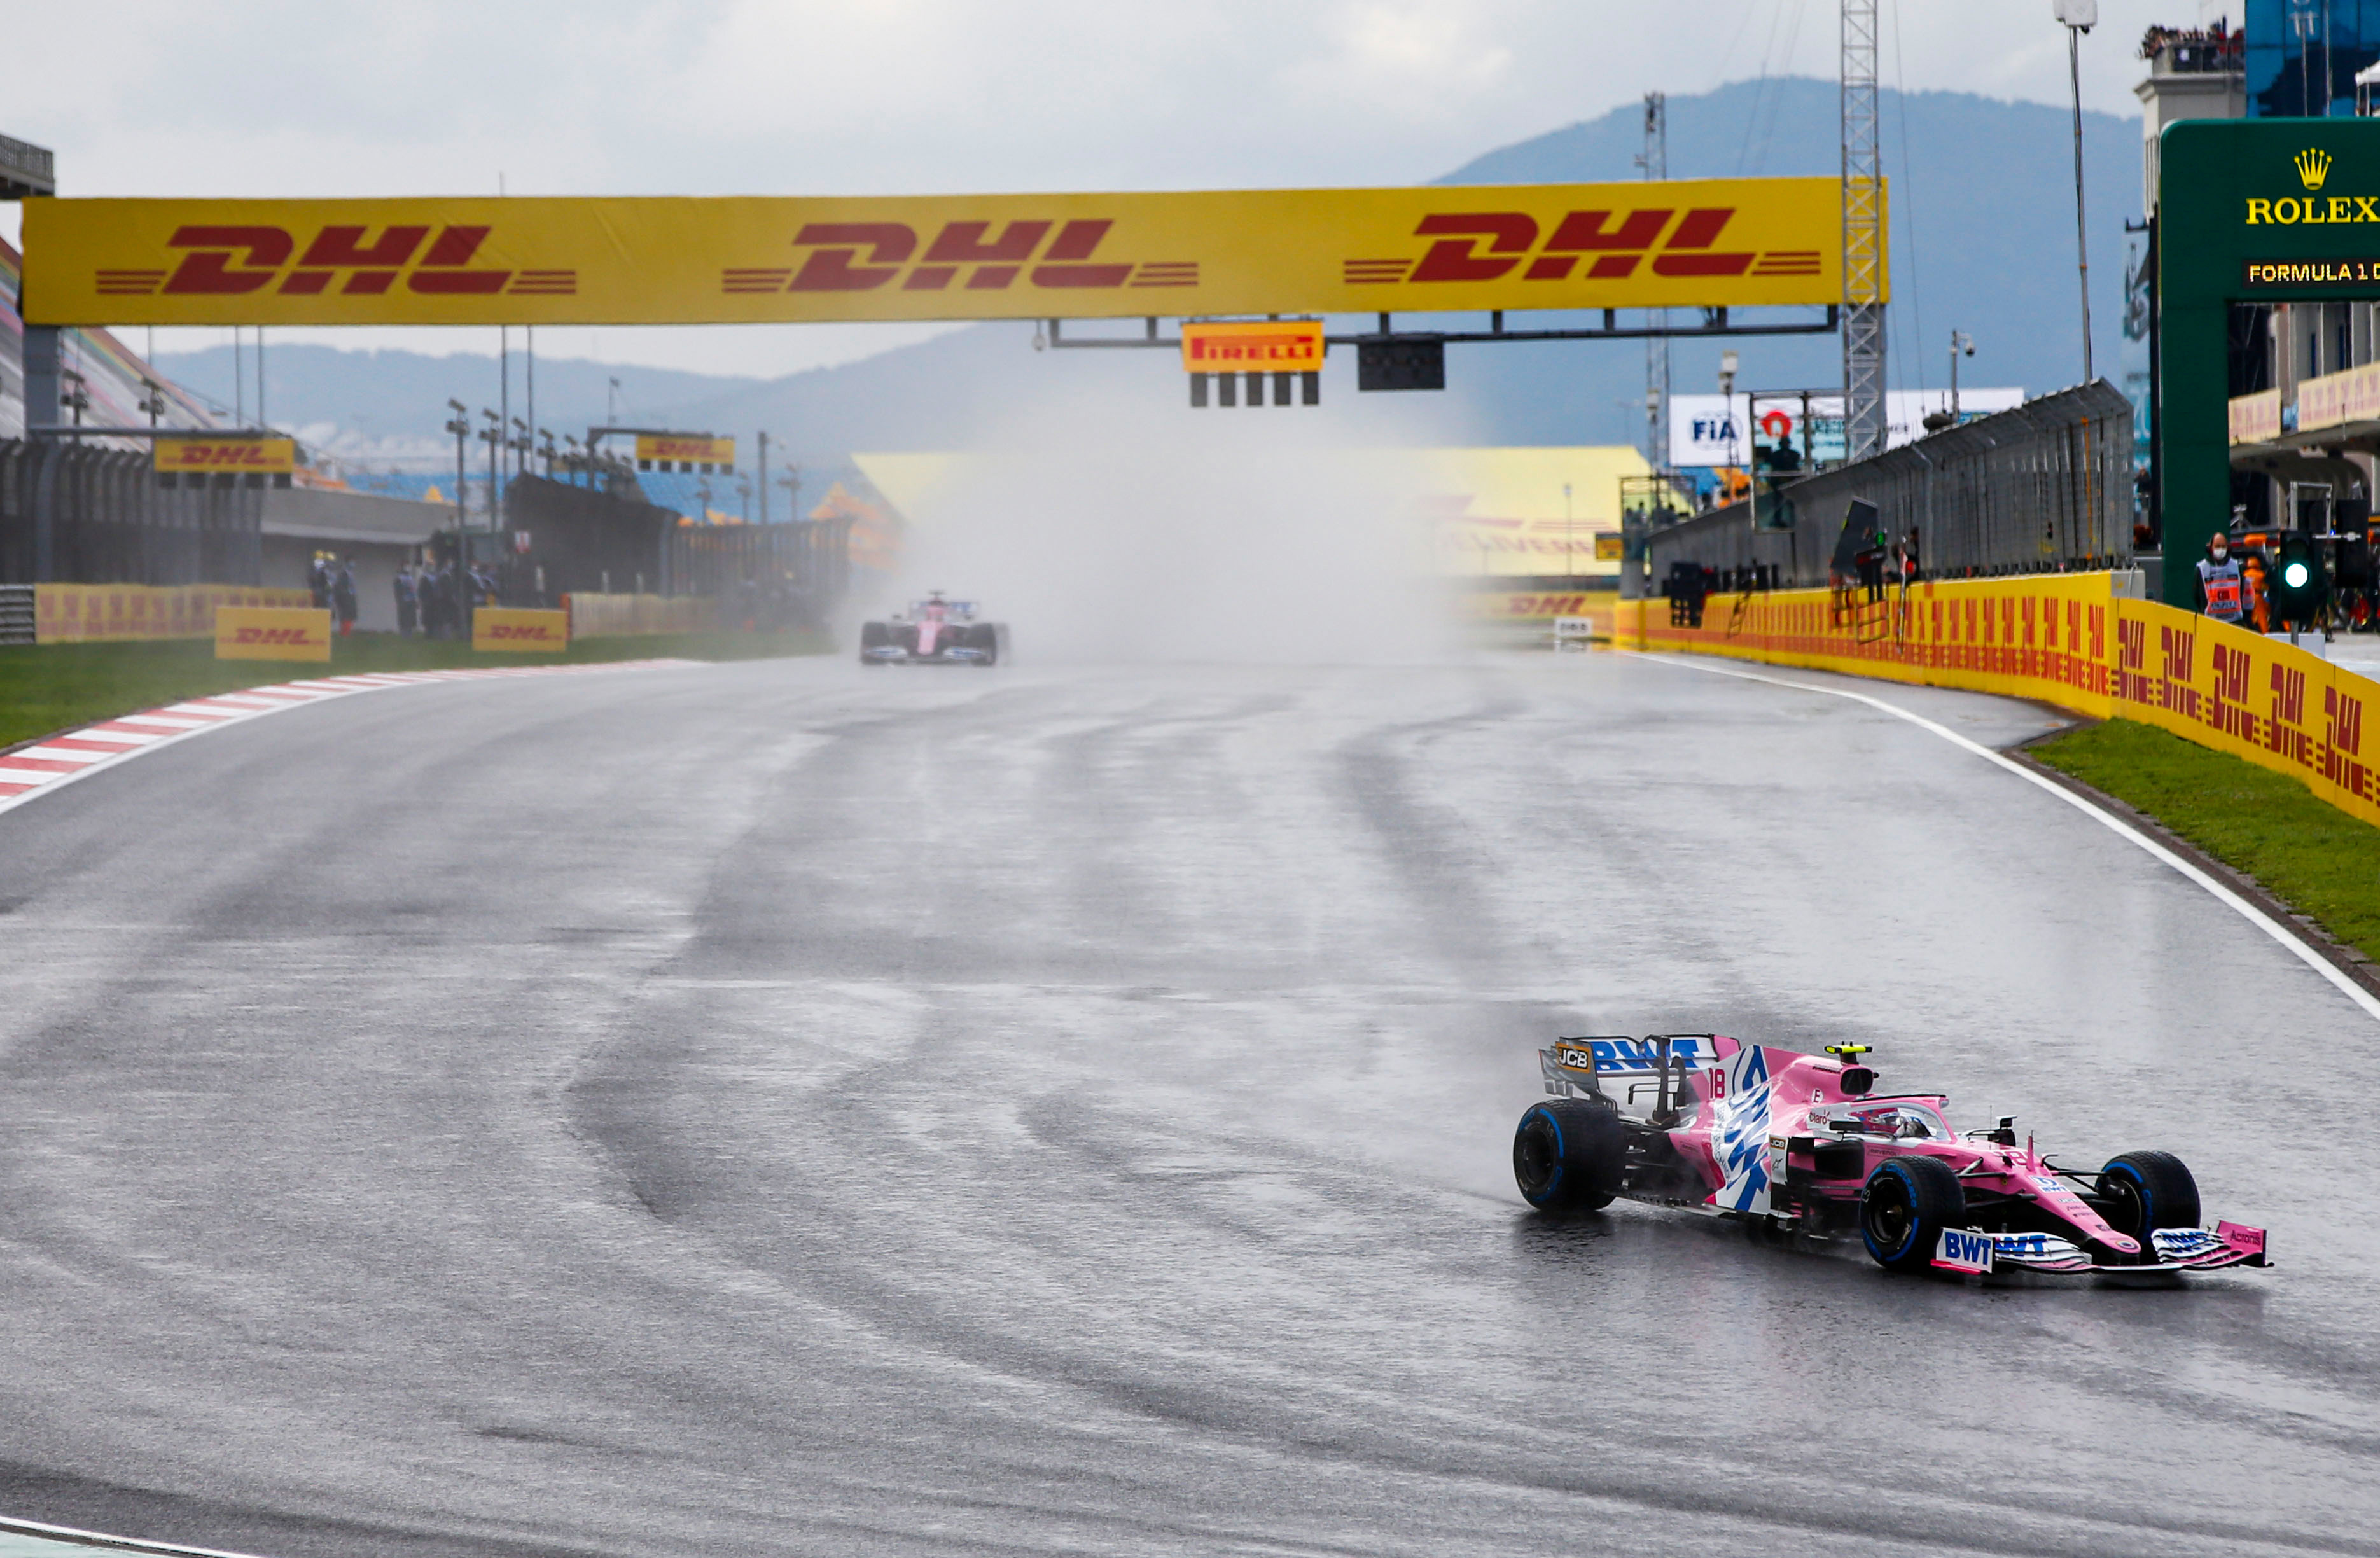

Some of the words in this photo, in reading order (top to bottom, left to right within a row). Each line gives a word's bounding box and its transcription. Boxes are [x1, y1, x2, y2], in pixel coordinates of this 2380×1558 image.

[2246, 197, 2380, 224] ROLEX
[787, 219, 1134, 292] DHL
[1407, 207, 1757, 282] DHL
[162, 225, 511, 295] DHL
[2249, 263, 2352, 282] FORMULA
[2358, 263, 2368, 281] 1
[1191, 335, 1314, 359] PIRELLI
[179, 446, 268, 464] DHL
[235, 627, 310, 645] DHL
[1559, 1050, 1588, 1068] JCB
[1590, 1040, 1699, 1071] BWT
[1708, 1068, 1725, 1099] 18
[1771, 1139, 1785, 1148] JCB
[1945, 1232, 1991, 1265] BWT
[2230, 1230, 2261, 1246] Acronis
